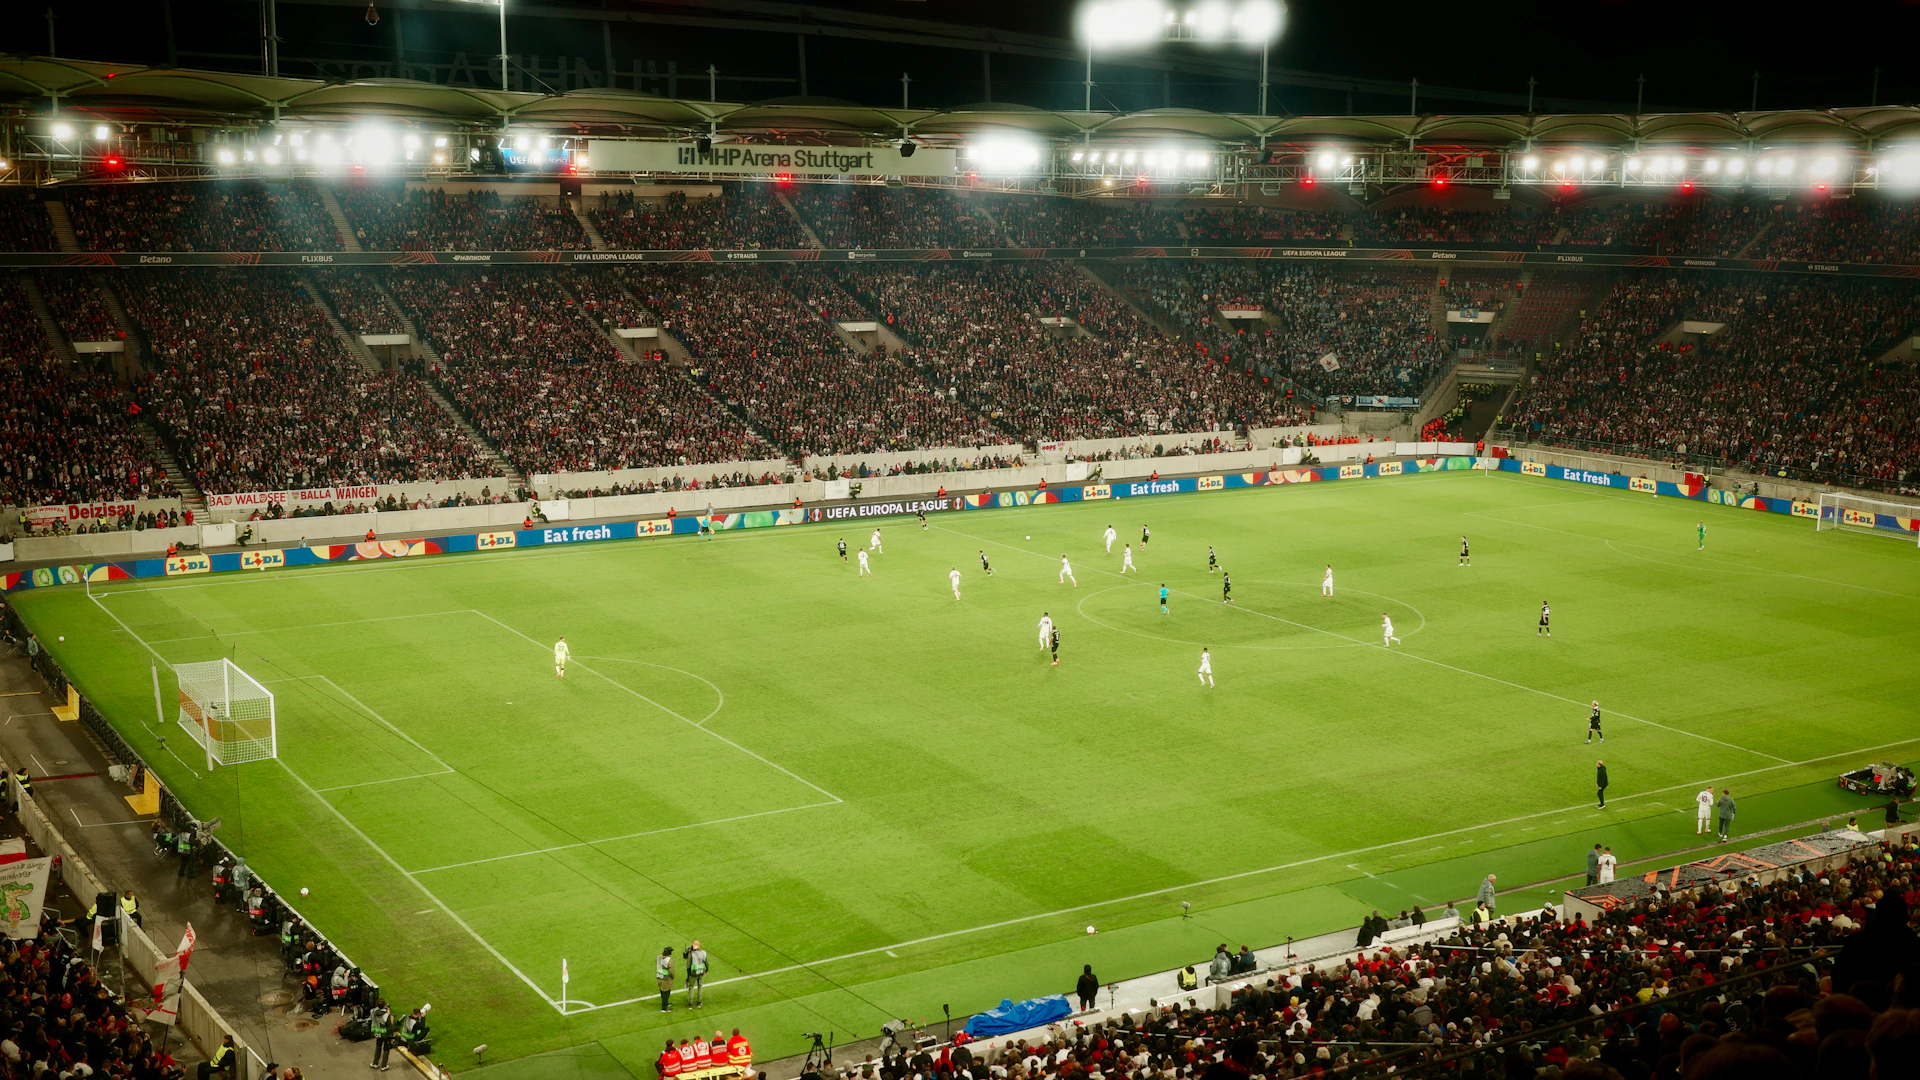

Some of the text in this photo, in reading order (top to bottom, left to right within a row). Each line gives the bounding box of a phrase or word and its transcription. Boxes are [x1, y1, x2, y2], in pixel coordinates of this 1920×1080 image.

[701, 148, 874, 173] MHP Arena Stuttgart
[139, 255, 172, 264] Betano
[1563, 469, 1611, 486] Eat fresh
[300, 489, 331, 500] BALLA
[335, 486, 378, 499] WANGEN
[1130, 480, 1179, 495] Eat fresh
[210, 492, 286, 507] BAD WALDSEE
[68, 502, 136, 520] Deizisau
[826, 499, 948, 519] UEFA EUROPA LEAGUE
[544, 525, 611, 543] Eat fresh
[1701, 795, 1708, 803] 10
[1605, 859, 1610, 867] 4
